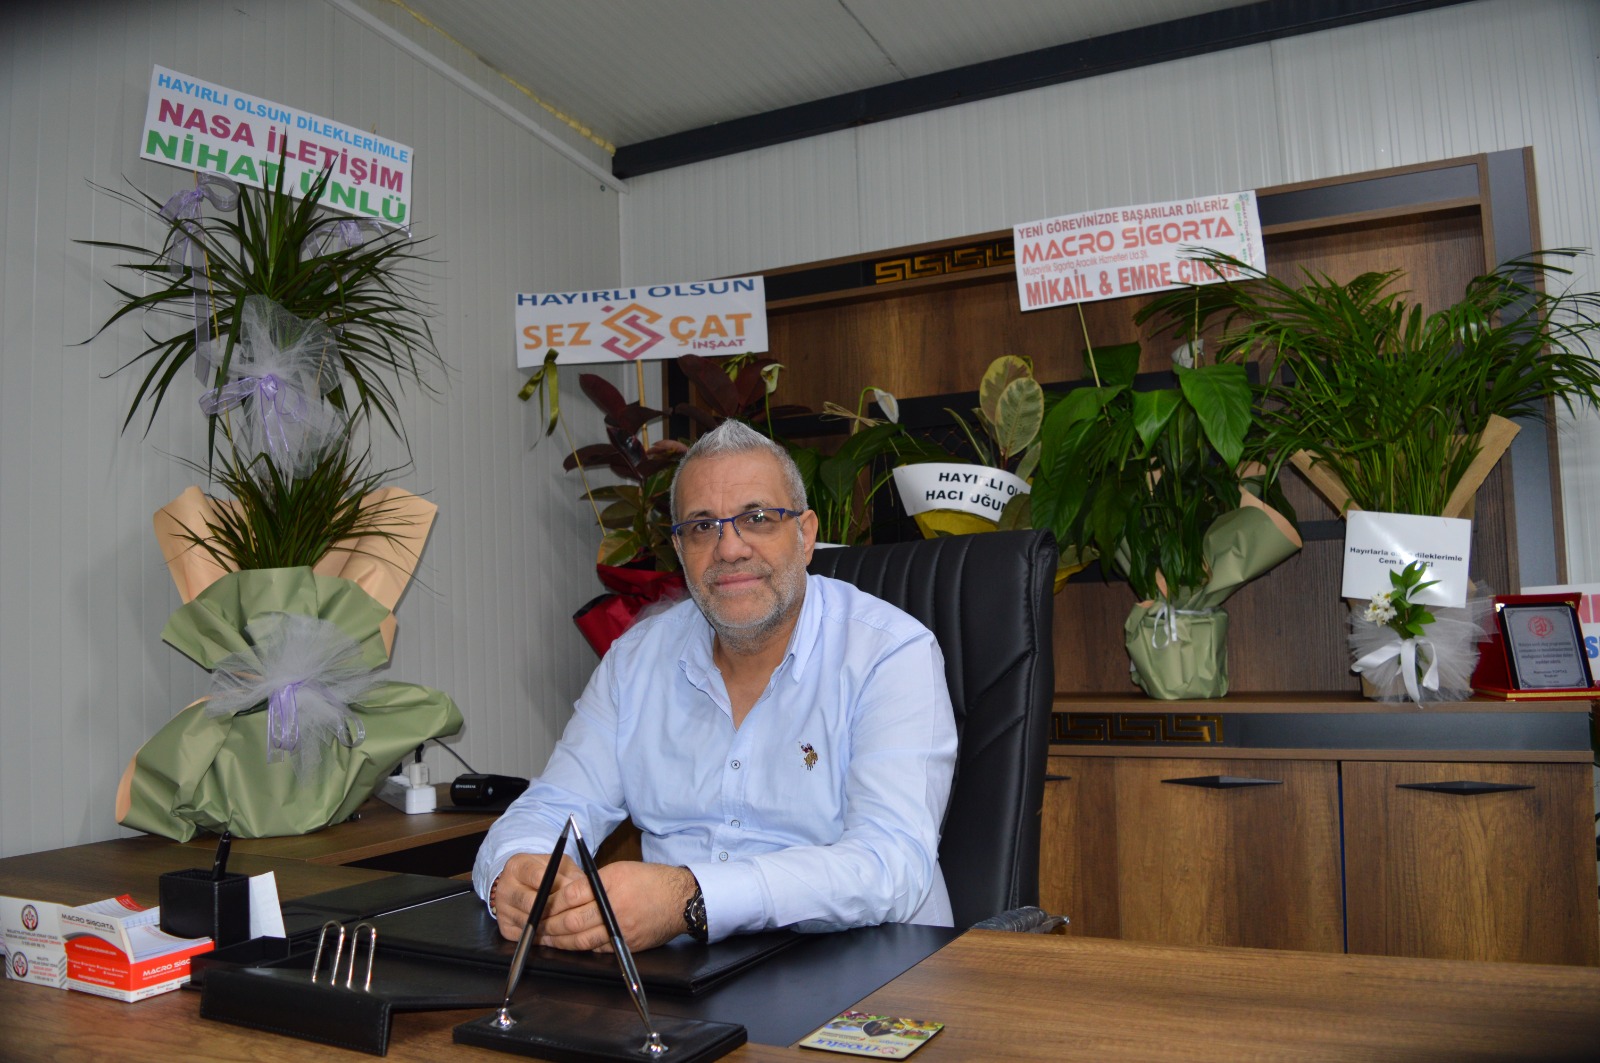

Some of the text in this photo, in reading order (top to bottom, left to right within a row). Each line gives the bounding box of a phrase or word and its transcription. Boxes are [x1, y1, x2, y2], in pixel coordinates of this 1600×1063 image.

[158, 73, 409, 163] HAYIRLI OLSUN DİLEKLERİMLE
[158, 98, 404, 193] NASA İLETİŞİM
[145, 129, 406, 224] NİHAT ÜNLÜ
[1018, 197, 1230, 240] YENİ GÖREVİNİZDE BAŞARILAR DİLERİZ
[1022, 230, 1115, 265] MACRO
[1121, 216, 1235, 249] SİGORTA
[1053, 261, 1075, 274] Sigorta
[517, 279, 755, 306] HAYIRLI OLSUN
[1025, 269, 1094, 307] MİKAİL
[1099, 270, 1114, 296] &
[1117, 261, 1172, 293] EMRE
[523, 313, 752, 350] SEZ ÇAT
[692, 338, 747, 350] İNŞAAT
[938, 472, 1004, 491] HAYILI
[926, 490, 963, 501] HACI
[1350, 546, 1389, 556] Hayırlarla
[1414, 551, 1463, 562] dileklerimle
[1378, 557, 1397, 565] Cem
[61, 913, 85, 924] MACRO
[143, 963, 173, 977] MACRO
